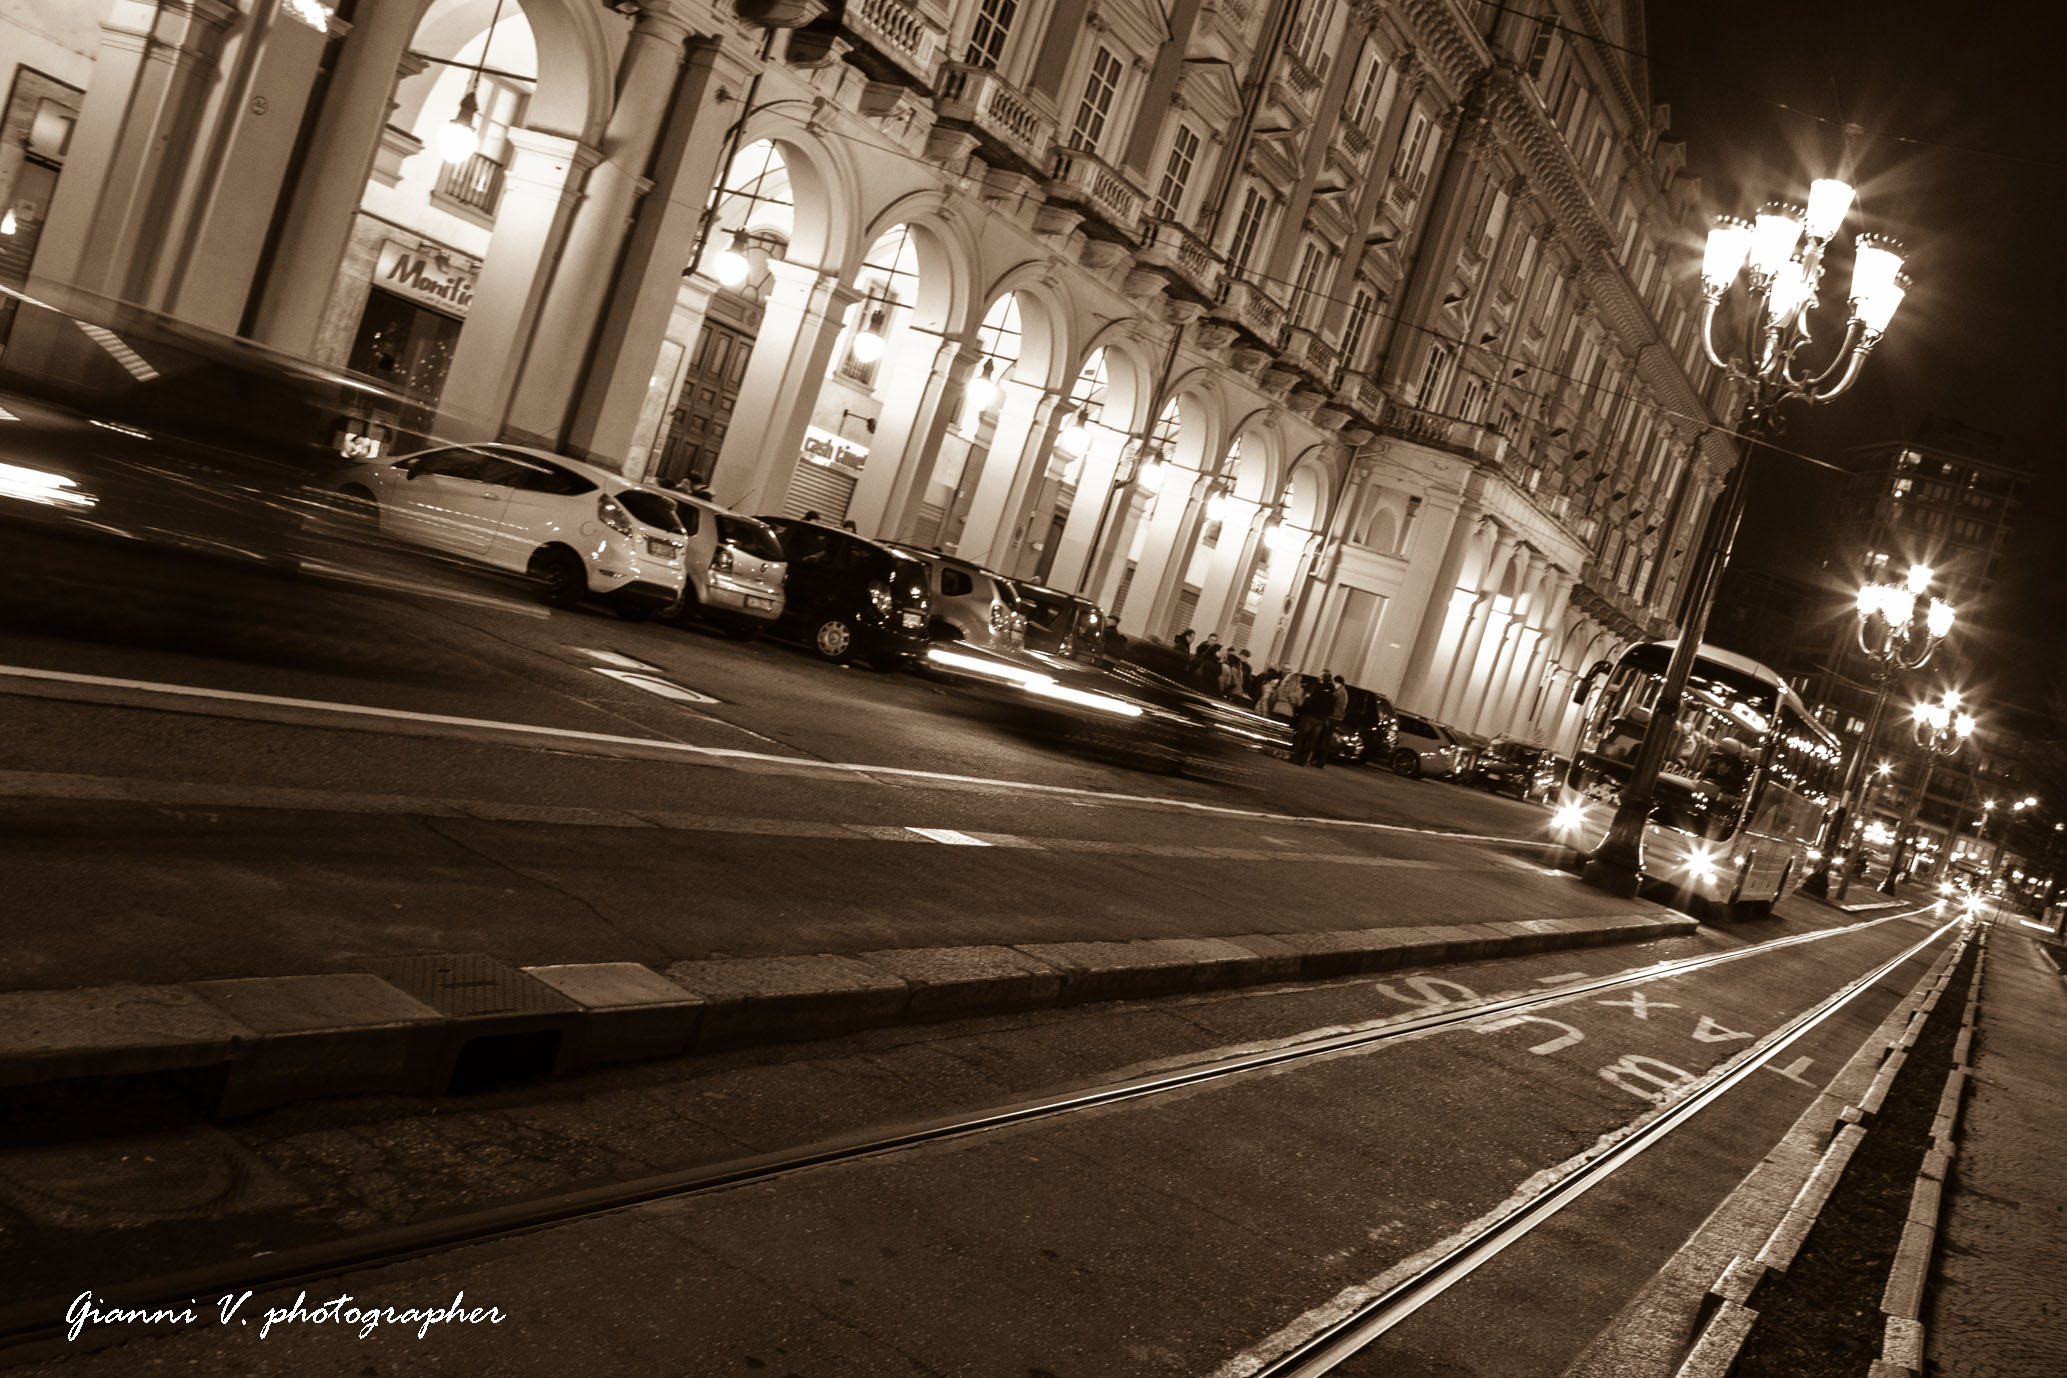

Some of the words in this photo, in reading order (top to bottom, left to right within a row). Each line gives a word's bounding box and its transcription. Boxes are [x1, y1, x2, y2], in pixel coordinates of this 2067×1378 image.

[805, 437, 833, 460] cash
[1375, 975, 1708, 1102] BUS
[1540, 971, 1818, 1089] TAXI
